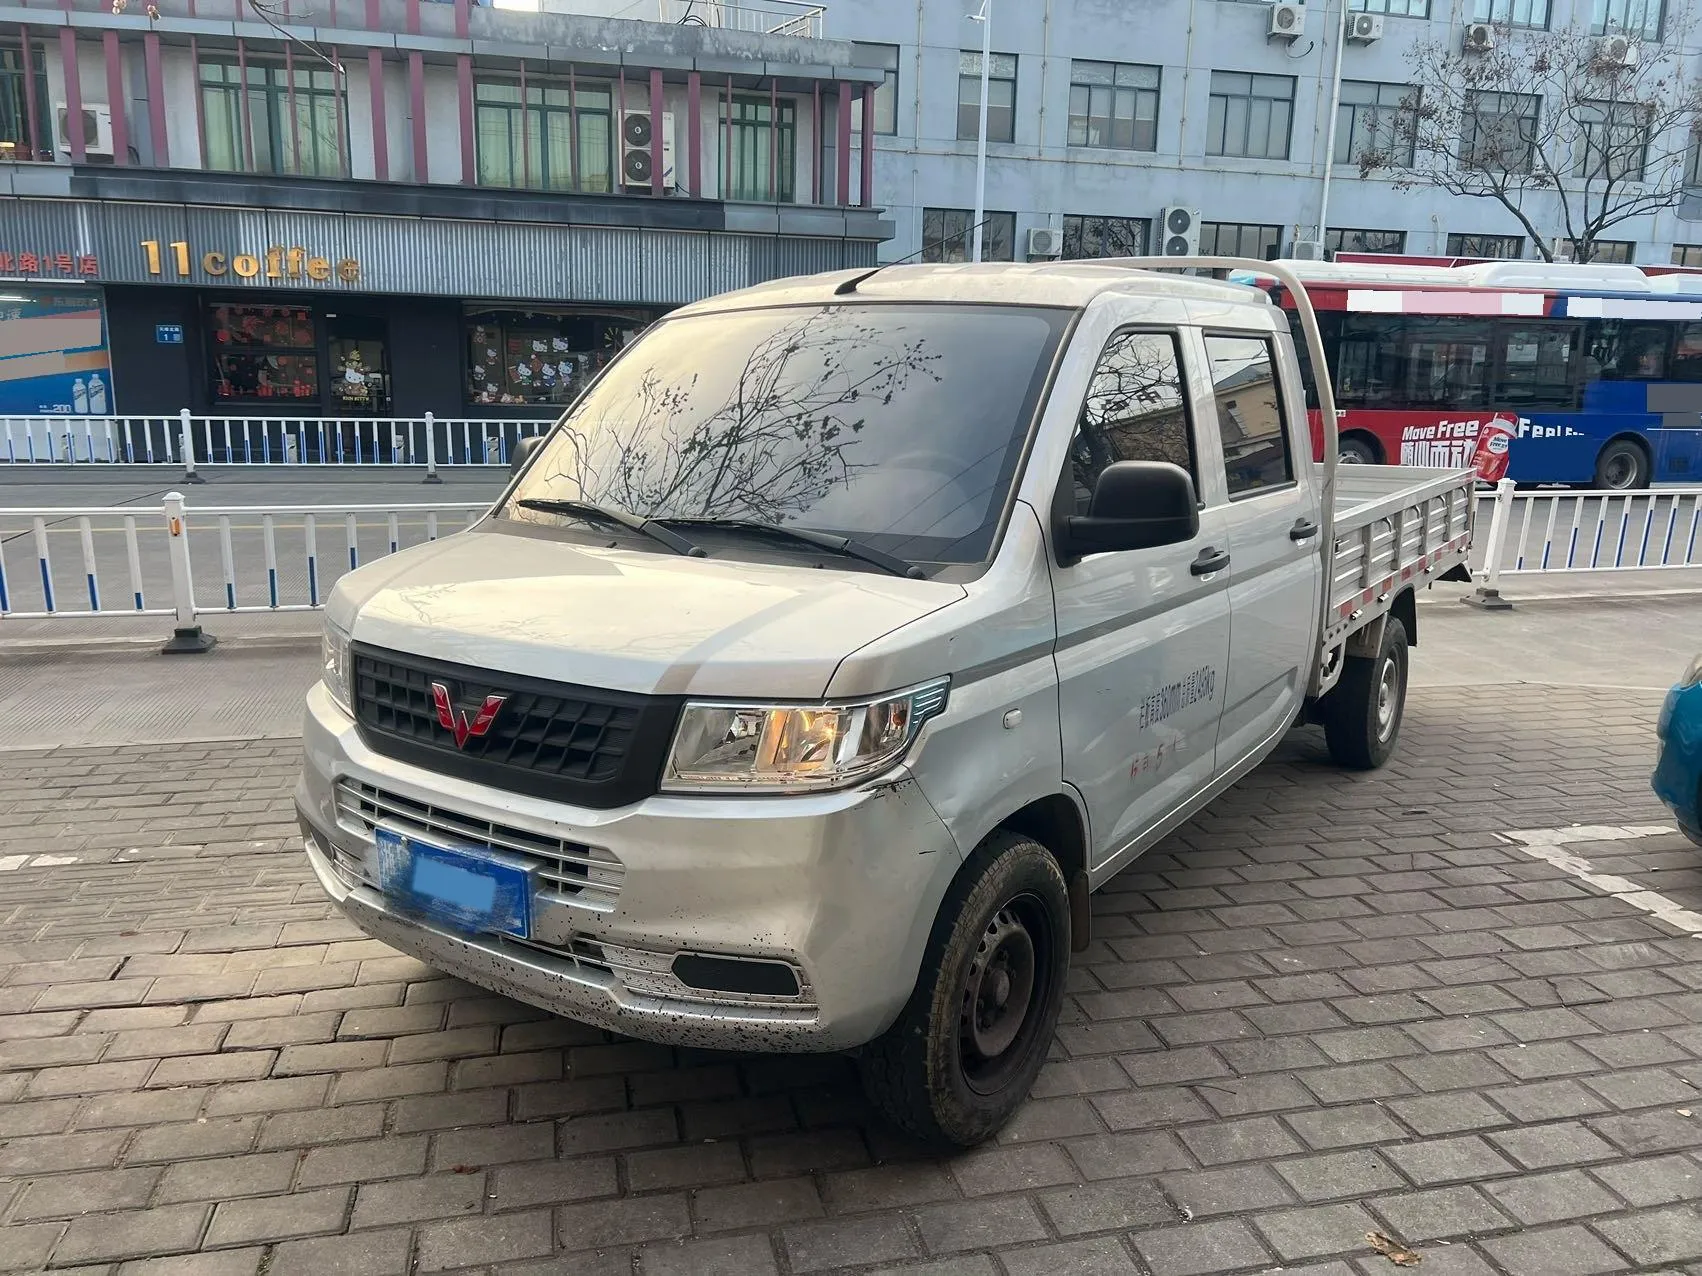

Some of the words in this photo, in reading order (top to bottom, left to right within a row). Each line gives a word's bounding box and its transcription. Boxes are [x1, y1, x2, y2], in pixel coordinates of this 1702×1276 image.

[141, 241, 190, 275] 11
[202, 246, 360, 281] coffee
[1402, 426, 1435, 441] Move
[1437, 420, 1479, 438] Free
